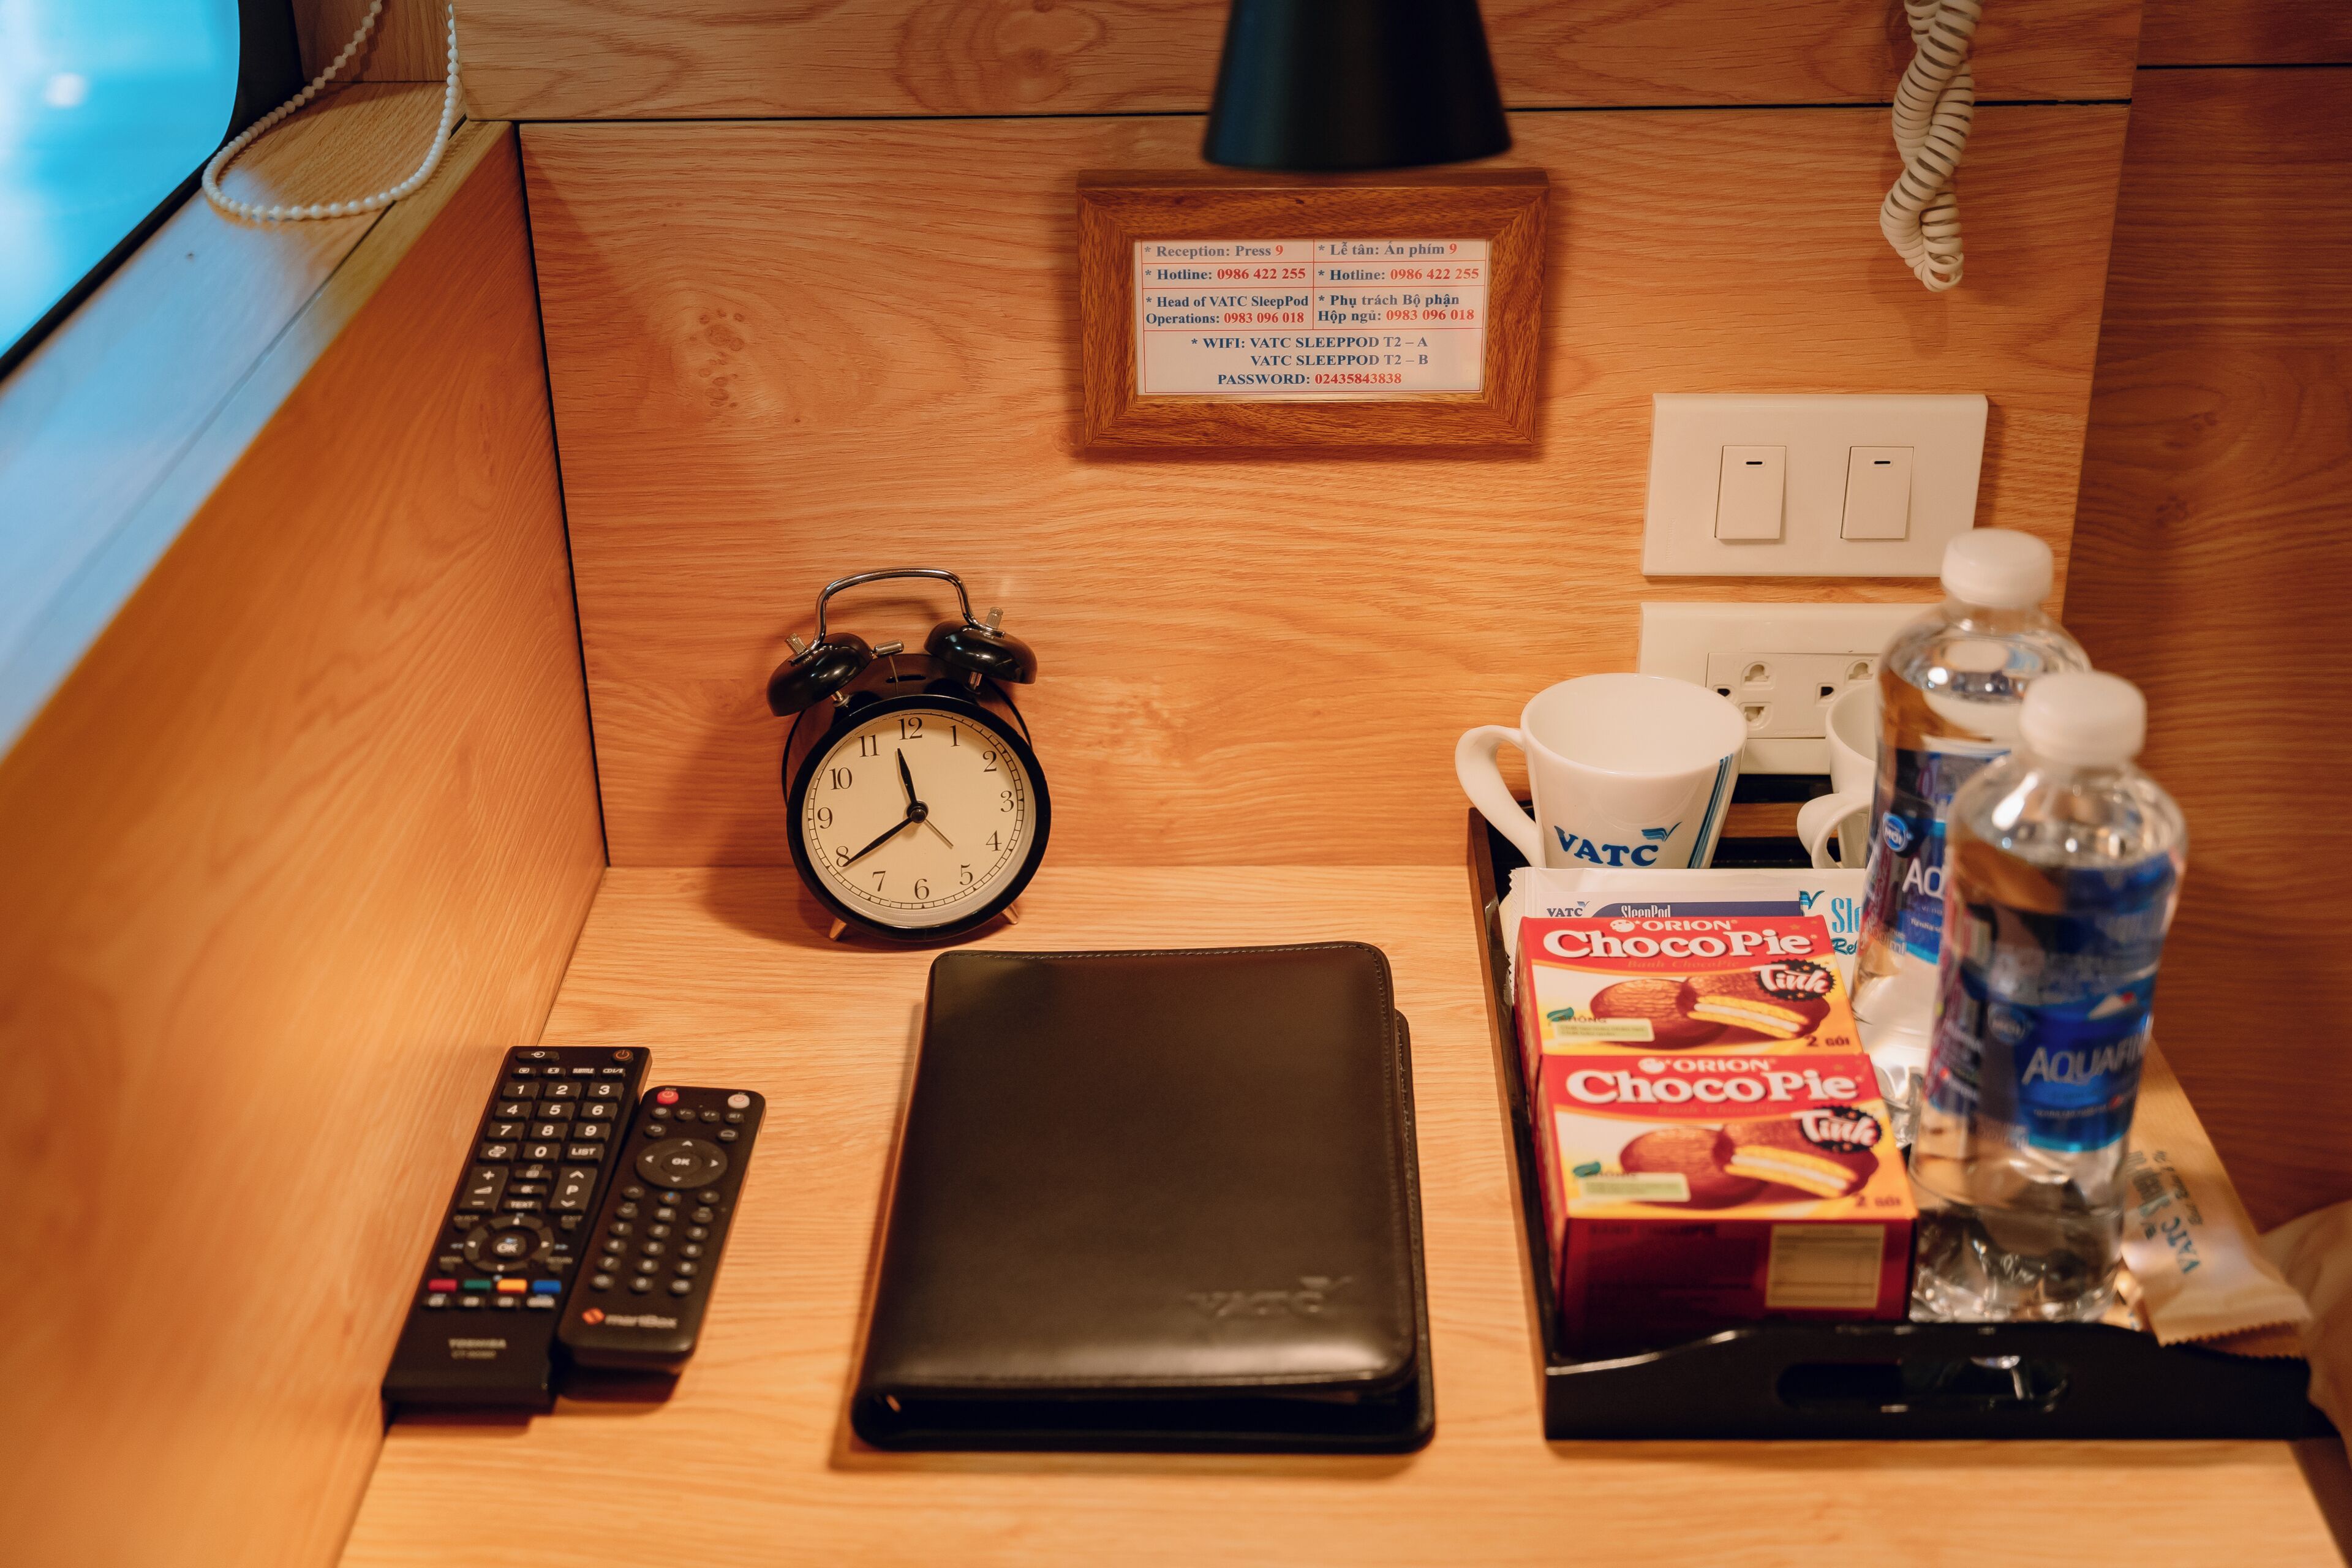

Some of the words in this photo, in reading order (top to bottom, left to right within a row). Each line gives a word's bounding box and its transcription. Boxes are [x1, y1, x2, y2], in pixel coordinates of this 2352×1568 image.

[1156, 246, 1230, 259] Reception:
[1235, 246, 1271, 256] Press
[1275, 245, 1283, 255] 9
[1330, 241, 1348, 255] Lễ
[1352, 244, 1379, 255] tân:
[1409, 243, 1444, 257] phím
[1449, 243, 1457, 254] 9
[1157, 269, 1212, 280] Hotline:
[1217, 268, 1249, 280] 0986
[1253, 268, 1277, 279] 422
[1281, 268, 1306, 279] 255
[1330, 270, 1385, 281] Hotline:
[1390, 268, 1422, 280] 0986
[1427, 268, 1450, 279] 422
[1455, 268, 1479, 279] 255
[1157, 296, 1189, 307] Head
[1194, 296, 1207, 307] of
[1209, 296, 1247, 307] VATC
[1251, 295, 1308, 309] SleepPod
[1330, 295, 1357, 308] Phụ
[1362, 295, 1397, 306] trách
[1403, 294, 1420, 307] Bộ
[1425, 294, 1460, 307] phận
[1146, 313, 1219, 326] Operations:
[1224, 312, 1253, 323] 0983
[1257, 312, 1278, 323] 096
[1283, 312, 1305, 323] 018
[1318, 310, 1346, 324] Hộp
[1351, 310, 1381, 323] ngủ:
[1386, 309, 1418, 321] 0983
[1422, 309, 1446, 320] 096
[1450, 309, 1474, 320] 018
[1203, 337, 1245, 349] WIFI:
[1250, 337, 1291, 348] VATC
[1295, 337, 1379, 348] SLEEPPOD
[1384, 336, 1401, 347] T2
[1417, 336, 1428, 347] A
[1250, 355, 1292, 366] VATC
[1297, 354, 1379, 366] SLEEPPOD
[1384, 354, 1401, 365] T2
[1417, 354, 1428, 365] B
[1218, 374, 1310, 385] PASSWORD:
[1314, 373, 1401, 385] 02435843838
[897, 717, 923, 740] 12
[949, 725, 960, 747] 1
[859, 734, 880, 757] 11
[982, 751, 997, 772] 2
[829, 767, 852, 790] 10
[1000, 791, 1014, 812] 3
[817, 807, 832, 829] 9
[986, 831, 1002, 852] 4
[1554, 826, 1659, 867] VATC
[835, 846, 850, 867] 8
[872, 871, 886, 892] 7
[959, 864, 973, 886] 5
[914, 879, 930, 900] 6
[1547, 908, 1583, 917] VATC
[1642, 920, 1732, 932] ORION
[1544, 929, 1812, 958] ChocoPie
[1805, 1034, 1819, 1047] 2
[1673, 1058, 1771, 1073] ORION
[518, 1085, 525, 1094] 1
[556, 1085, 568, 1095] 2
[598, 1085, 610, 1095] 3
[1566, 1069, 1858, 1103] ChocoPie
[507, 1105, 518, 1115] 4
[549, 1105, 561, 1115] 5
[592, 1105, 603, 1115] 6
[500, 1125, 511, 1135] 7
[541, 1125, 554, 1136] 8
[584, 1125, 597, 1136] 9
[534, 1146, 547, 1157] 0
[672, 1158, 690, 1166] OK
[566, 1185, 579, 1195] P
[497, 1243, 518, 1253] OK
